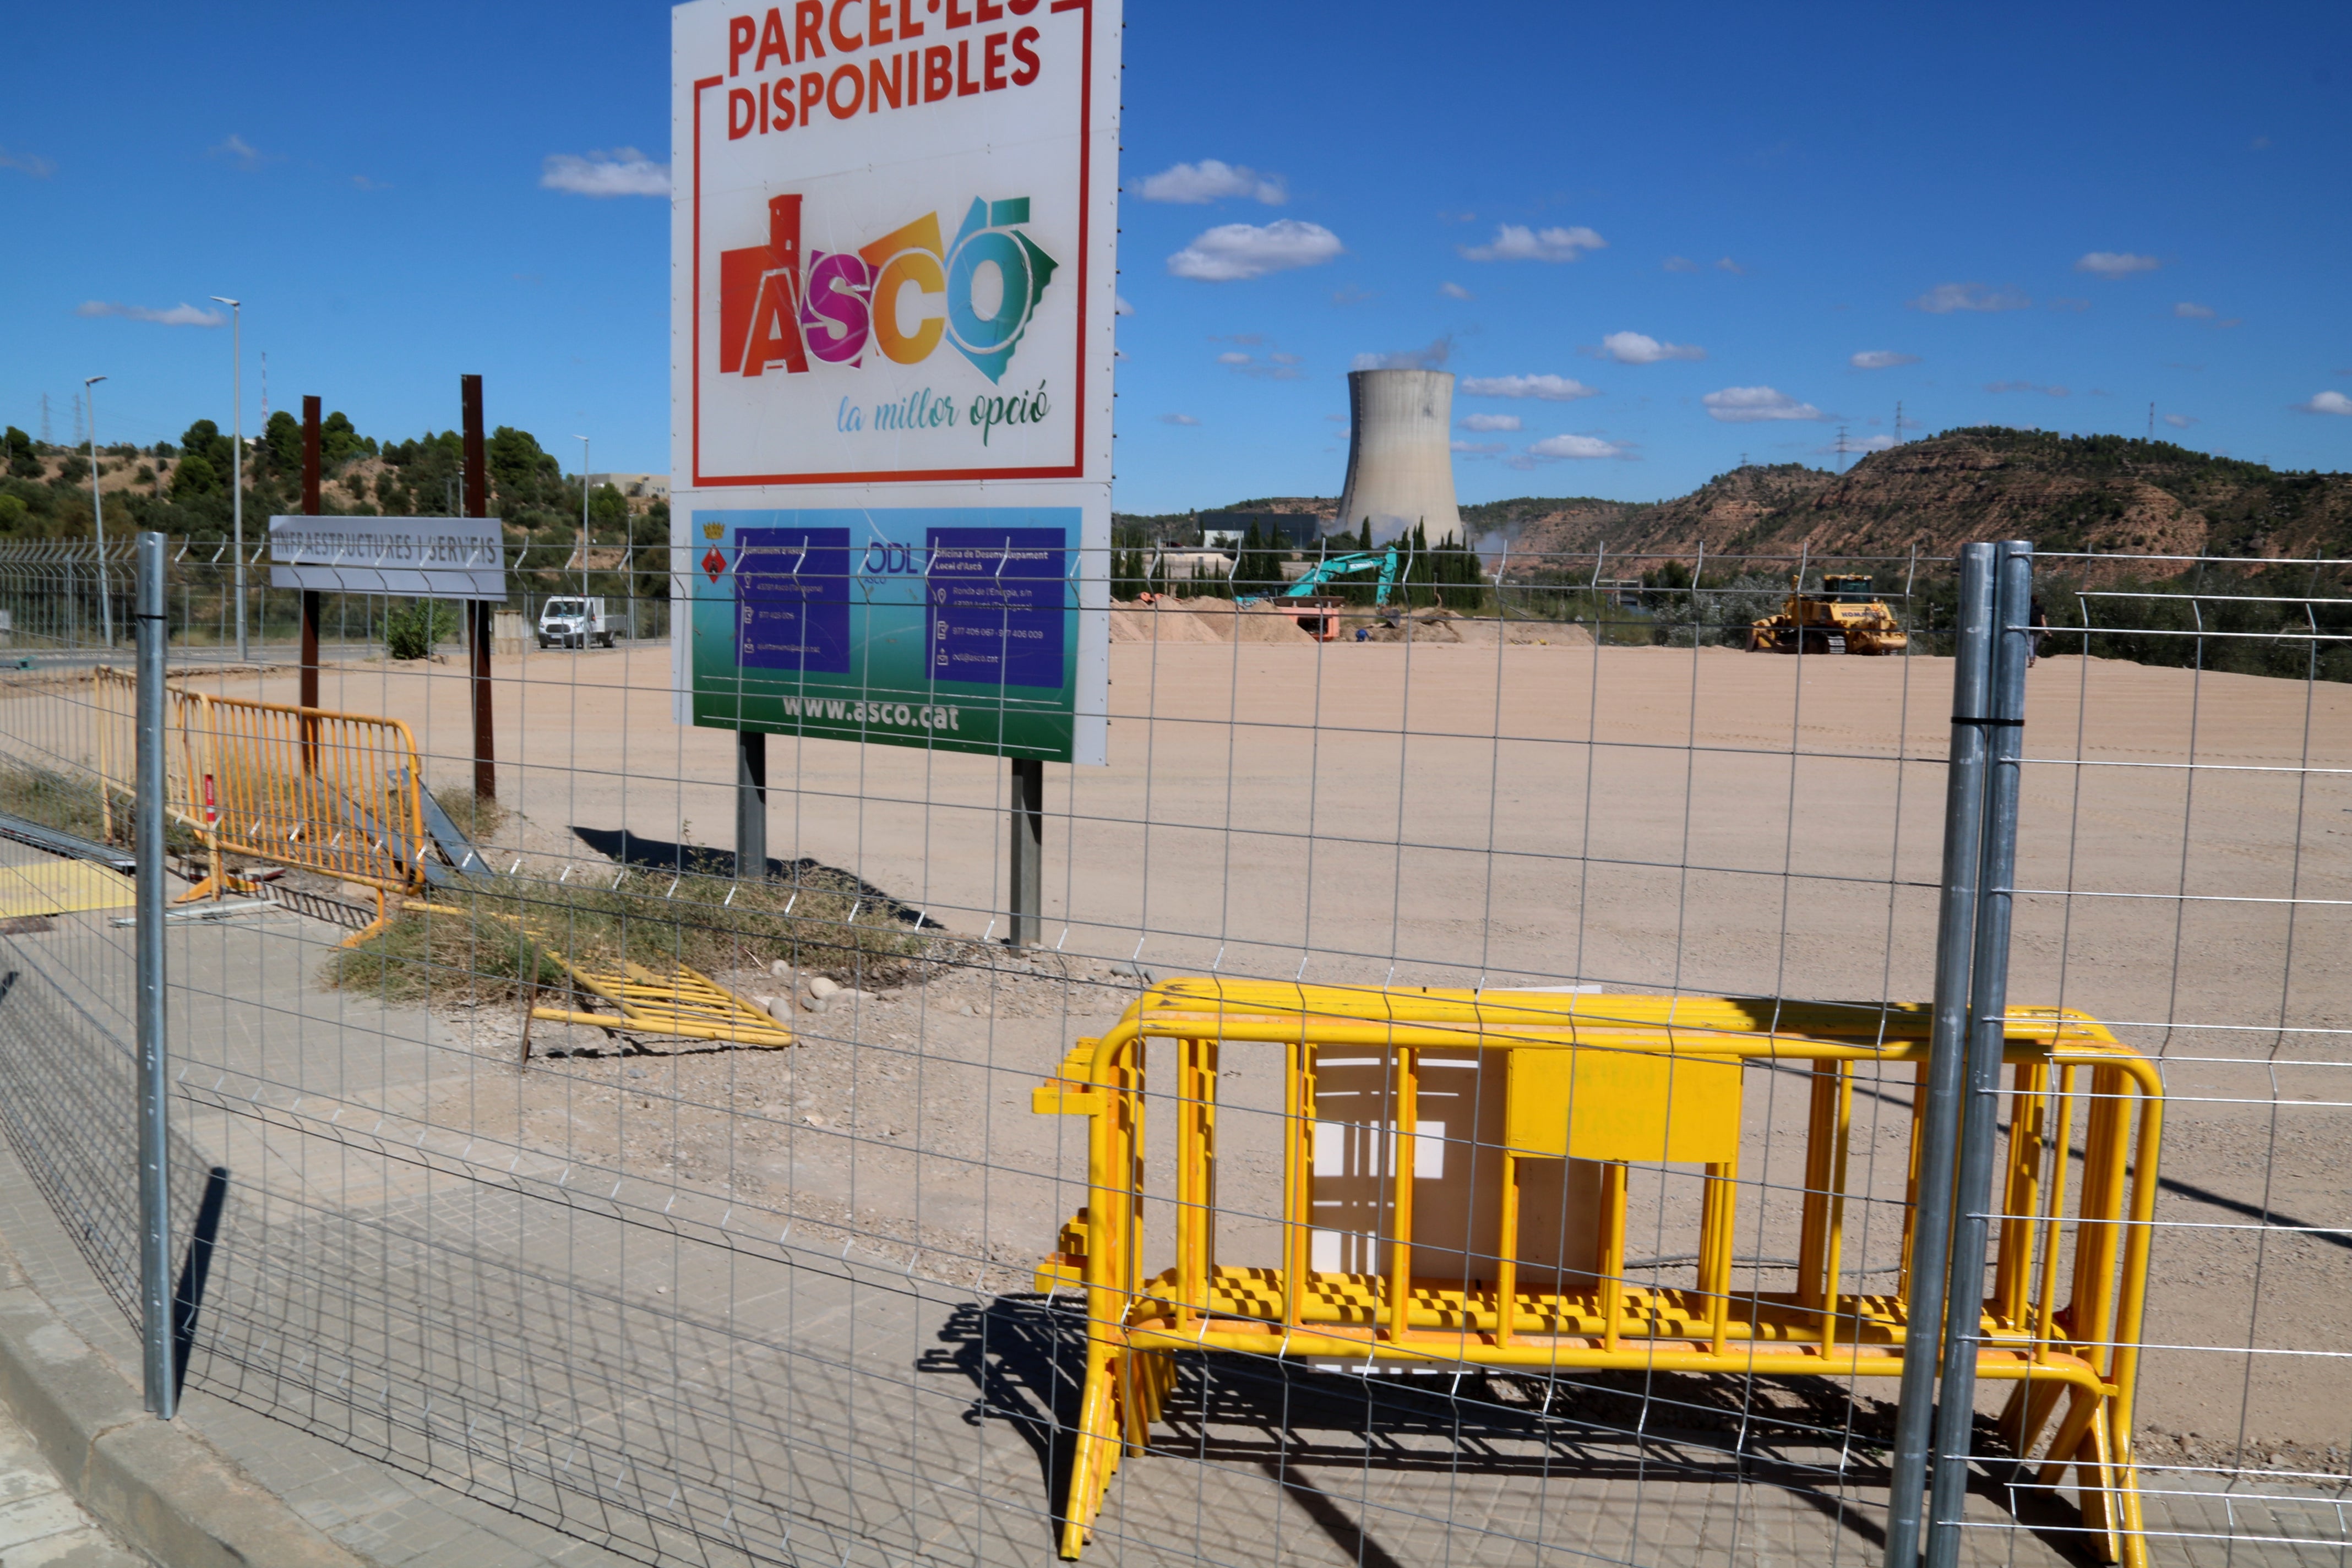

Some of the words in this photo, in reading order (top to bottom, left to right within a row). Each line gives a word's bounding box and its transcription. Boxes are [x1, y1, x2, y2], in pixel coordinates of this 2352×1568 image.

[729, 0, 1039, 78] PARCEL·
[728, 26, 1041, 140] DISPONIBLES
[721, 194, 1046, 381] ASCÓ
[837, 396, 866, 432] la
[874, 387, 959, 431] millor
[970, 379, 1050, 447] opció
[276, 531, 411, 560] INFRAESTRUCTURES
[417, 535, 422, 560] I
[428, 535, 496, 564] SERVEIS
[865, 542, 918, 574] ODL
[935, 549, 962, 558] Oficina
[963, 549, 974, 558] de
[975, 550, 1048, 560] Desenvlupament
[935, 562, 956, 570] Local
[952, 587, 975, 595] Ronda
[976, 587, 985, 596] de
[952, 627, 965, 635] 977
[998, 629, 1011, 638] 97
[783, 696, 960, 731] www.asco.cat
